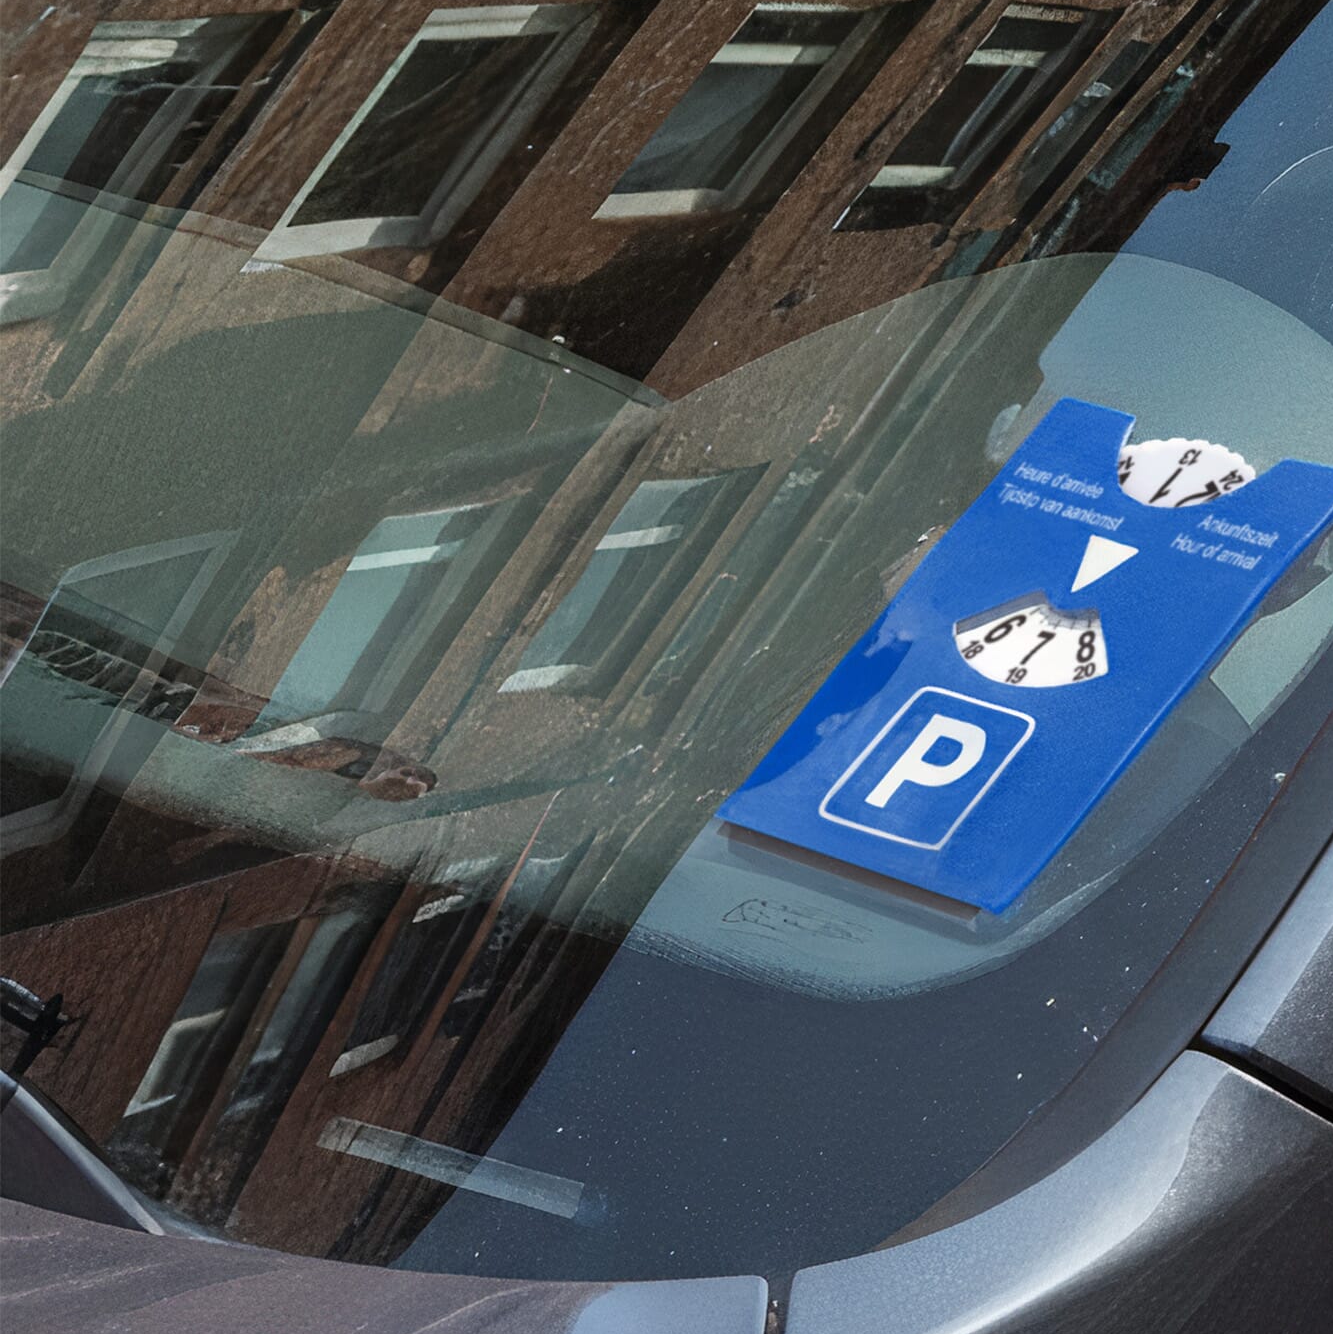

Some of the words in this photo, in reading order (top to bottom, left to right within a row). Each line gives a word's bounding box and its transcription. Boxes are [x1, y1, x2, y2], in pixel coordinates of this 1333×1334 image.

[1014, 461, 1052, 484] Heure
[1178, 449, 1202, 466] 13
[1219, 469, 1244, 491] 24
[1040, 498, 1063, 514] van
[1061, 505, 1124, 531] aankomst
[1170, 532, 1205, 553] Hour
[1202, 543, 1223, 558] of
[1216, 549, 1261, 570] arrival
[984, 614, 1027, 644] 6
[1020, 631, 1056, 665] 7
[1076, 630, 1096, 663] 8
[961, 640, 984, 660] 18
[1005, 667, 1028, 684] 19
[1072, 662, 1096, 681] 20
[865, 713, 986, 807] P
